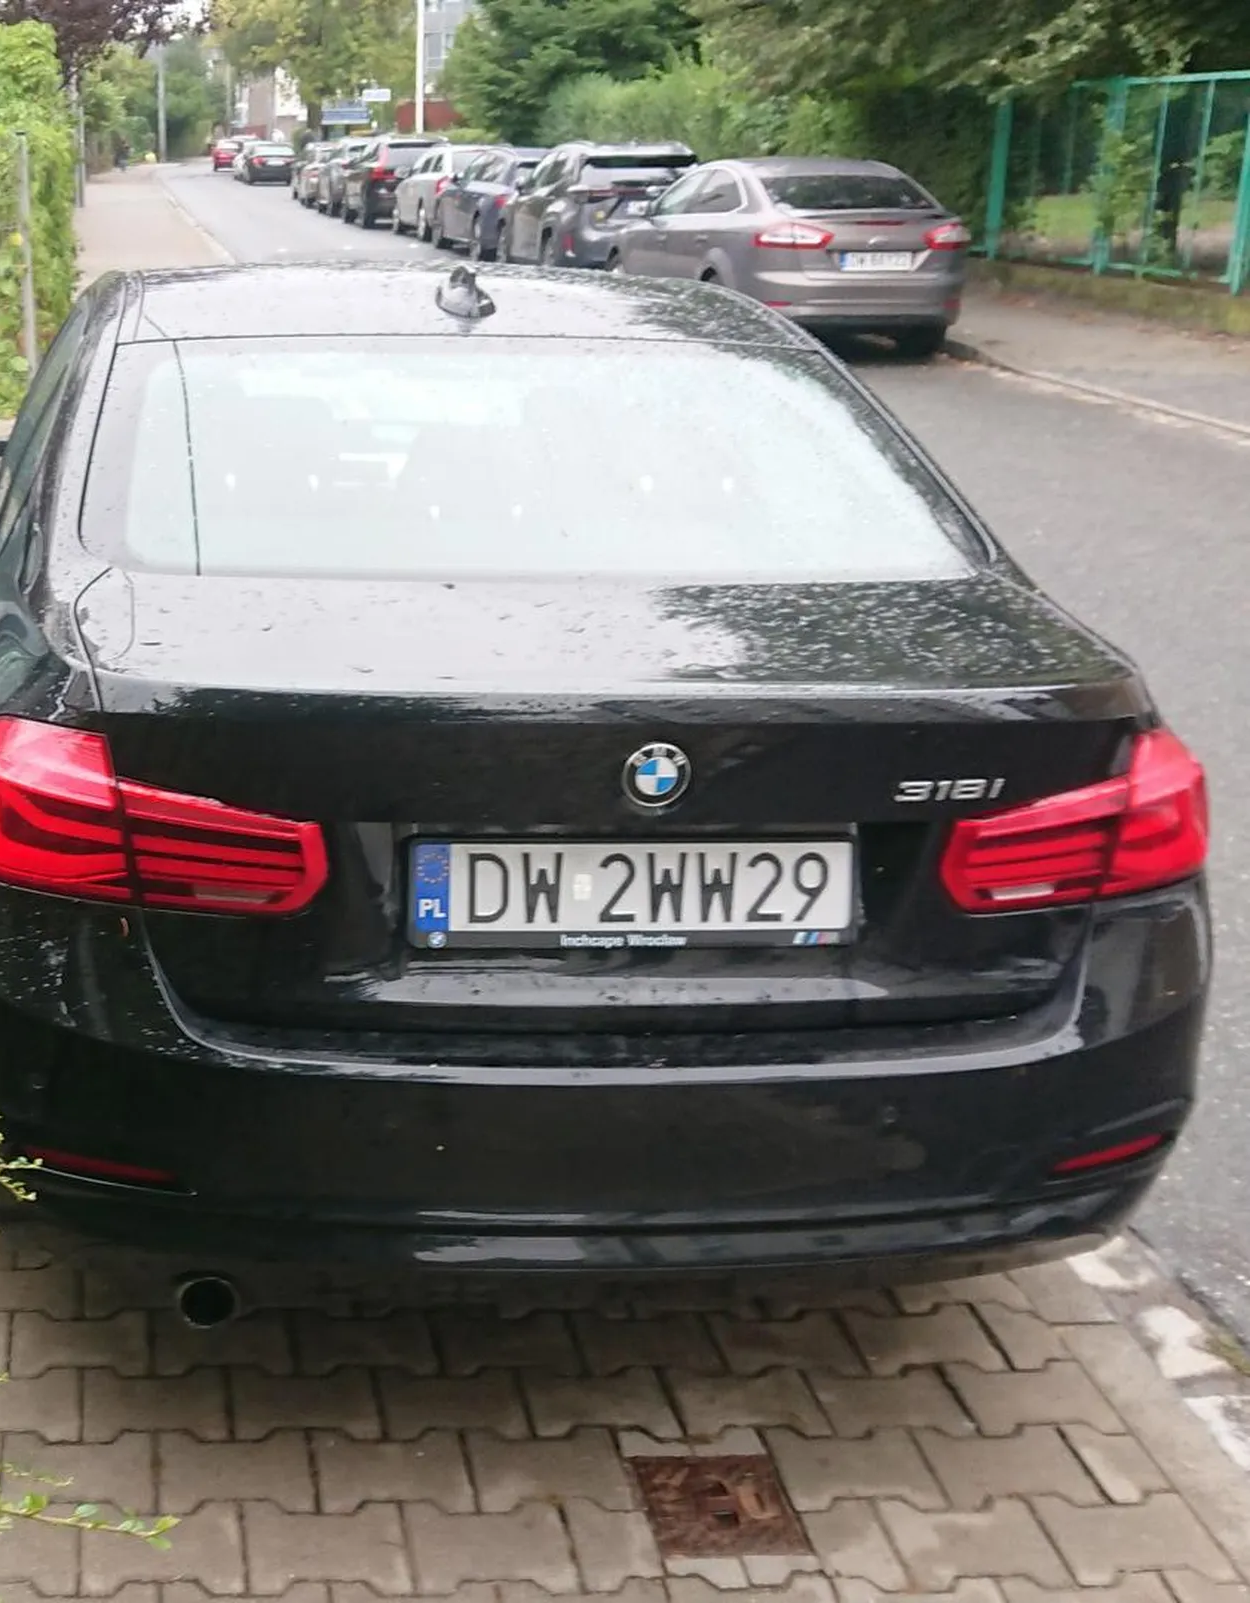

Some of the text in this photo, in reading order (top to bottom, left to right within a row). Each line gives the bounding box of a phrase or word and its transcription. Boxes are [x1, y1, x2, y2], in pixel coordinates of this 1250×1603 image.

[419, 898, 447, 918] PL
[468, 852, 829, 923] DW 2WW29
